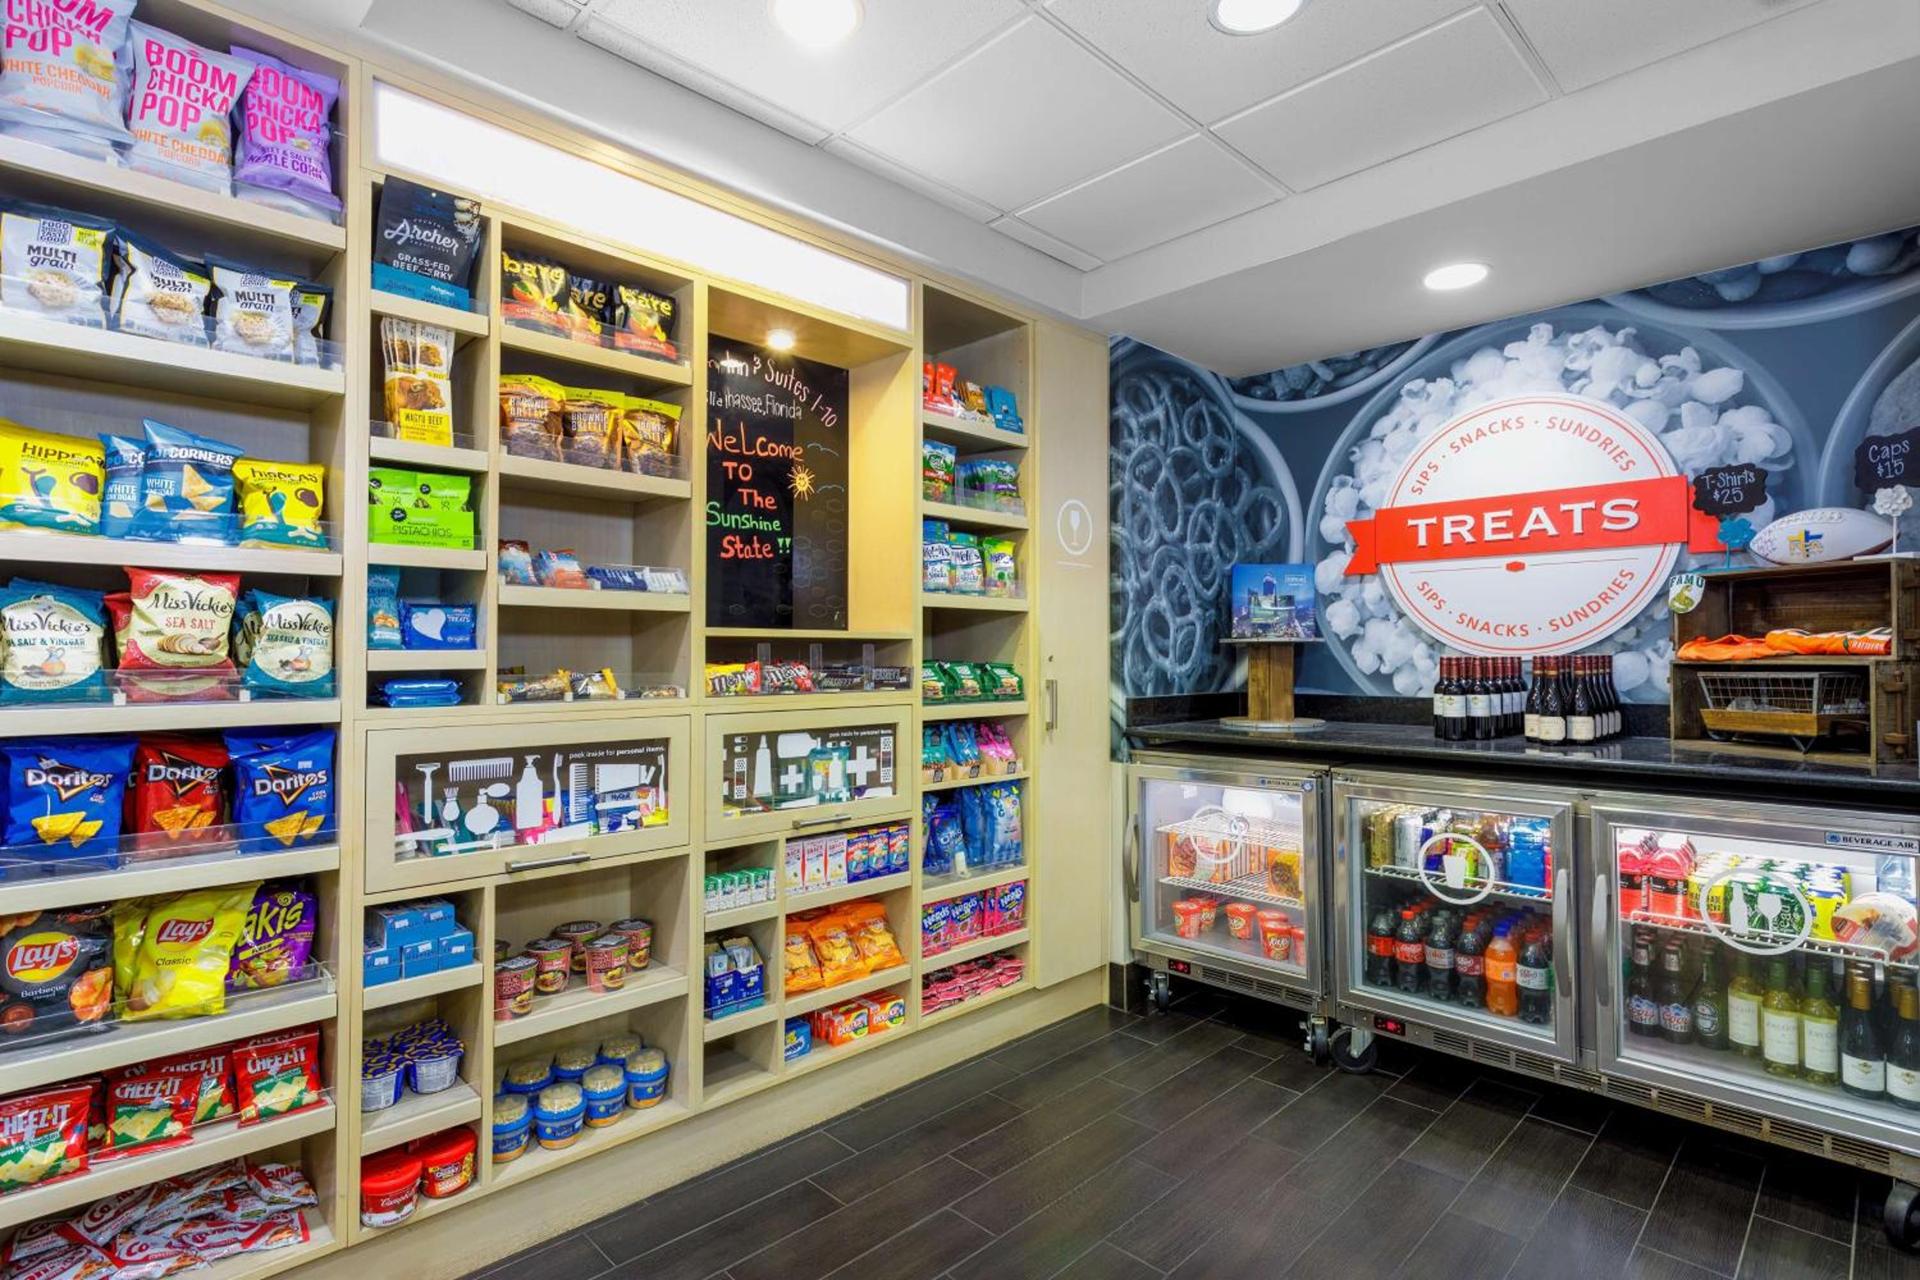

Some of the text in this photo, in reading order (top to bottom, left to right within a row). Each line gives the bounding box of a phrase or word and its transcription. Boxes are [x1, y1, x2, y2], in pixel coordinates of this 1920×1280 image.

[6, 24, 73, 56] POP
[145, 39, 238, 97] BOOM
[147, 68, 231, 115] CHICKA
[139, 92, 201, 132] POP
[246, 91, 321, 134] CHICKA
[246, 111, 297, 145] POP
[384, 218, 459, 256] Archer
[27, 245, 77, 262] MULTI
[30, 256, 74, 270] grain
[398, 253, 450, 271] GRASS-FED
[393, 260, 419, 272] BEEF
[502, 252, 565, 282] bare
[235, 290, 275, 304] MULTI
[571, 287, 607, 309] are
[619, 285, 672, 317] bare
[764, 358, 810, 403] Suites
[766, 393, 802, 419] Florida
[1411, 416, 1637, 495] SIPS SNACKS SUNDRIES
[1868, 439, 1910, 465] Caps
[1700, 470, 1756, 490] T-Shirts
[1877, 459, 1905, 480] $15
[147, 478, 176, 490] WHITE
[1713, 487, 1744, 505] $25
[738, 488, 777, 509] The
[1407, 498, 1641, 547] TREATS
[720, 535, 774, 560] State
[1670, 574, 1704, 588] FAMU
[147, 590, 234, 618] Miss Vickie's
[1416, 568, 1635, 637] SIPS SNACKS SUNDRIES
[34, 611, 91, 636] Vickie's
[166, 617, 217, 631] SEA SALT
[264, 613, 298, 630] Miss
[616, 747, 645, 756] personal
[26, 768, 112, 787] Doritos
[148, 763, 222, 782] Dorito
[254, 770, 328, 796] Doritos
[1000, 887, 1023, 908] Nerds
[240, 901, 305, 946] akis
[923, 905, 950, 928] Nerds
[158, 919, 213, 943] Lay's
[14, 940, 73, 970] Lay's
[155, 956, 193, 967] Classic
[115, 1078, 182, 1100] CHEEZ-IT
